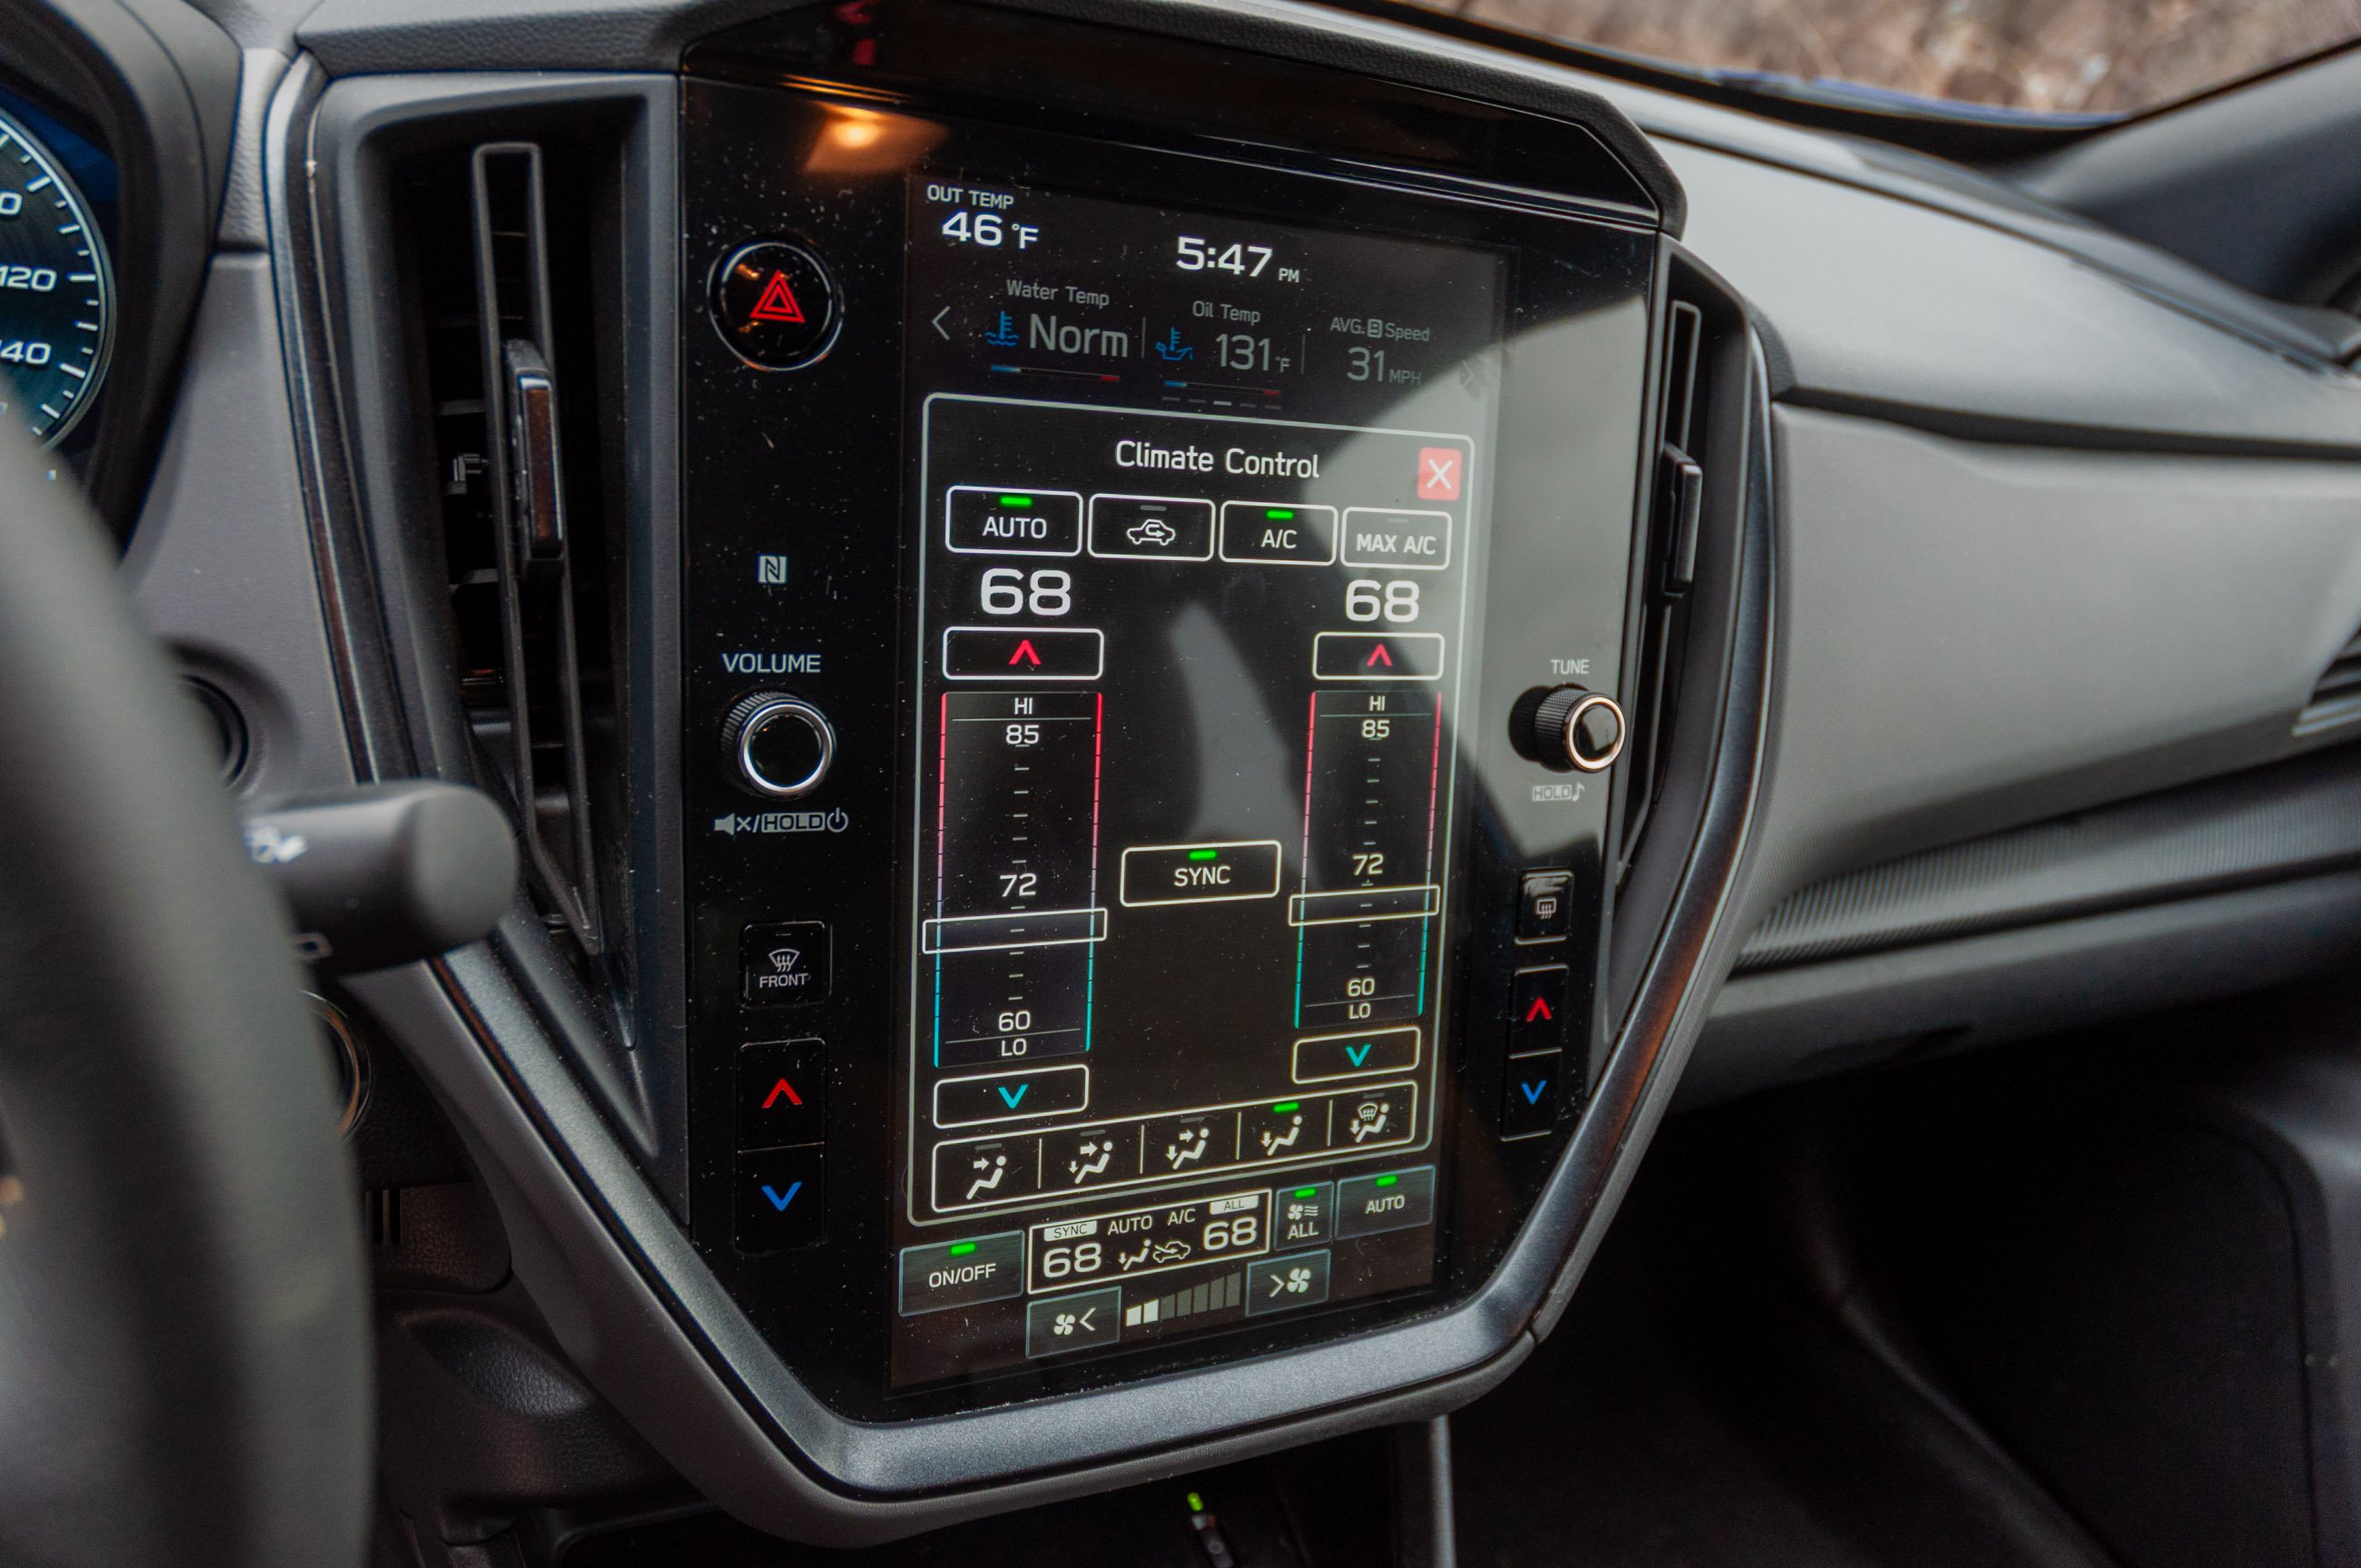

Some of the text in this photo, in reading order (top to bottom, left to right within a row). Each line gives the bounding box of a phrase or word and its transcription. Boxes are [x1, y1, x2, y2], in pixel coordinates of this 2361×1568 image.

[927, 183, 1013, 209] OUT TEMP
[943, 210, 1002, 246] 46
[1177, 236, 1299, 282] 5:47 PM
[1007, 280, 1109, 309] Water Temp
[1192, 301, 1260, 326] Oil Temp
[1031, 313, 1128, 357] Norm
[1385, 322, 1430, 341] Speed
[0, 340, 51, 364] 40
[1216, 334, 1269, 370] 131
[1347, 347, 1422, 385] 31 MPH
[1116, 440, 1319, 479] Climate Control
[983, 517, 1046, 538] AUTO
[1261, 529, 1297, 548] A/C
[1357, 534, 1436, 555] MAX A/C
[981, 568, 1071, 616] 68
[1345, 578, 1420, 623] 68
[722, 653, 821, 673] VOLUME
[1551, 659, 1589, 675] TUNE
[1014, 697, 1032, 715] HI
[1369, 695, 1385, 711] HI
[1005, 724, 1040, 744] 85
[1361, 718, 1390, 737] 85
[1353, 853, 1383, 875] 72
[1000, 873, 1036, 897] 72
[1174, 866, 1230, 886] SYNC
[759, 972, 808, 988] FRONT
[1348, 978, 1375, 997] 60
[1349, 1002, 1371, 1019] LO
[999, 1011, 1030, 1031] 60
[1001, 1038, 1027, 1056] LO
[1223, 1199, 1245, 1210] ALL
[1366, 1195, 1405, 1214] AUTO
[1107, 1215, 1153, 1235] AUTO
[1167, 1208, 1196, 1226] A/C
[1053, 1223, 1089, 1239] SYNC
[1203, 1217, 1258, 1250] 68
[1288, 1220, 1319, 1239] ALL
[1043, 1242, 1102, 1278] 68
[928, 1263, 997, 1287] ON/OFF
